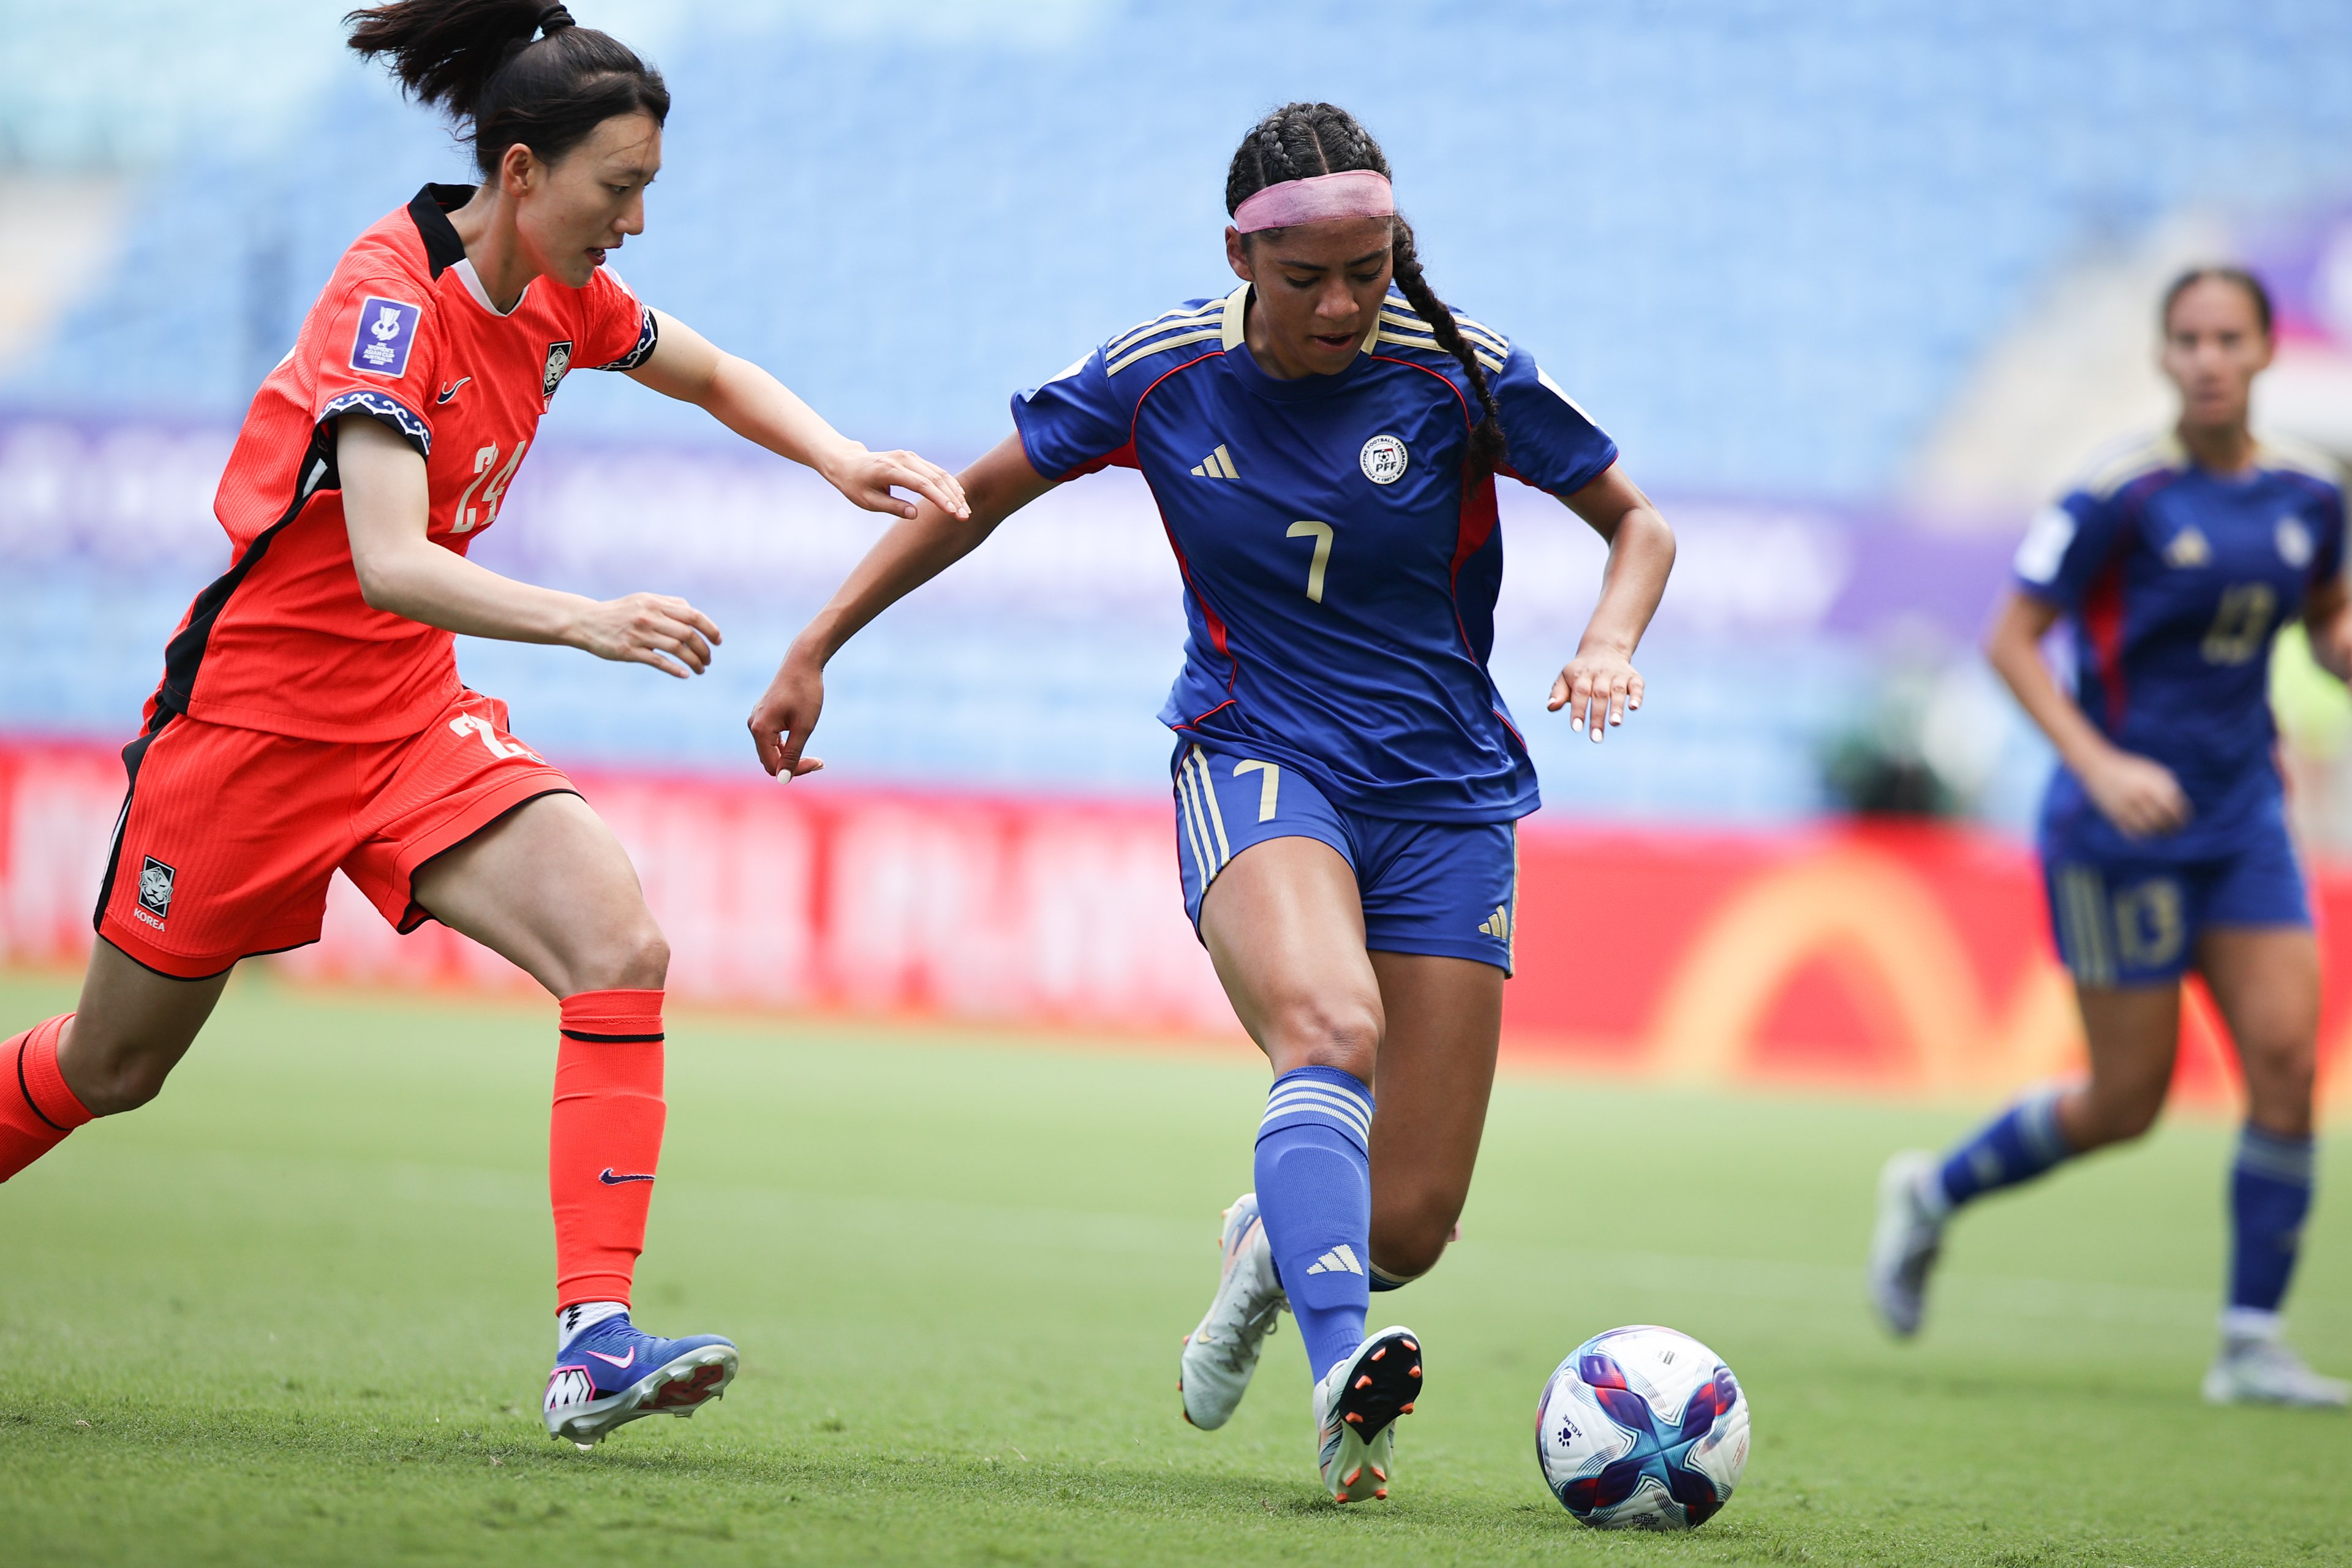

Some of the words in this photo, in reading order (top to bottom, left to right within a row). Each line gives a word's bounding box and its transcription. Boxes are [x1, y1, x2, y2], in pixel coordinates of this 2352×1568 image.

[1367, 438, 1394, 449] FOOTBALL
[1395, 442, 1406, 475] FEDERATION
[1363, 450, 1376, 478] PHILIPPINE
[1376, 461, 1397, 472] PFF
[449, 440, 527, 533] 24
[1286, 521, 1334, 603] 7
[1233, 758, 1280, 823] 7
[134, 908, 166, 932] KOREA
[2112, 876, 2185, 968] 13
[1562, 1414, 1583, 1438] KELME
